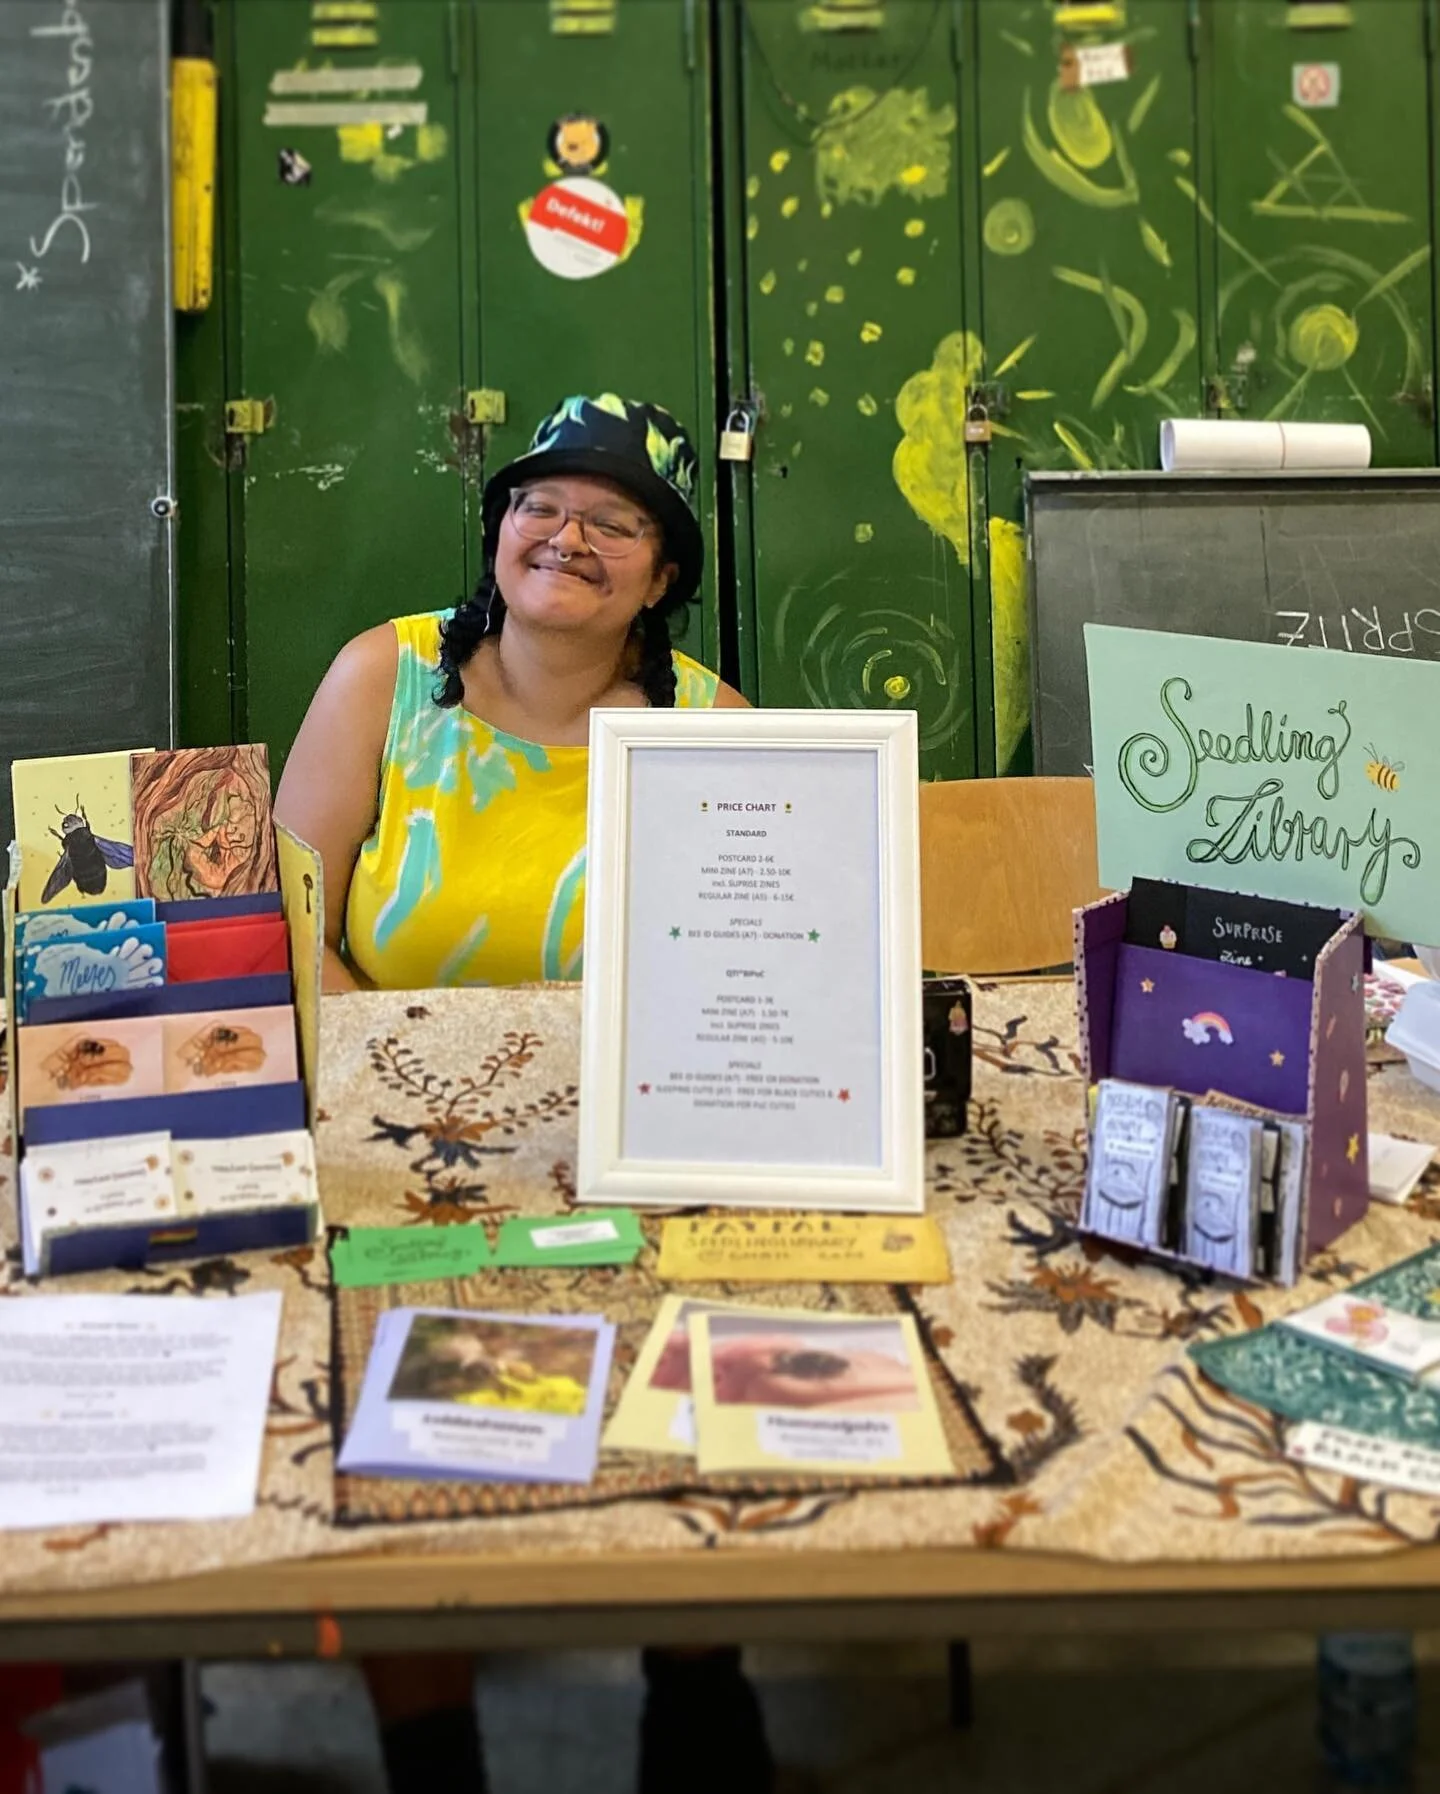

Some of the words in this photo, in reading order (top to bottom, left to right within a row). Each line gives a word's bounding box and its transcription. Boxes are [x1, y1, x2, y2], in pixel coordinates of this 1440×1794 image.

[15, 0, 99, 290] Spendenb
[1118, 677, 1351, 813] Seedling
[716, 802, 743, 812] PRICE
[745, 802, 777, 813] CHART
[726, 829, 767, 838] STANDARD
[1186, 778, 1421, 906] Library
[718, 854, 757, 863] POSTCARD
[701, 867, 718, 875] MINI
[720, 867, 736, 876] ZINE
[738, 867, 753, 877] (A7)
[759, 880, 780, 889] ZINES
[698, 892, 732, 901] REGULAR
[734, 892, 749, 901] ZINE
[729, 918, 763, 927] SPECIALS
[713, 930, 741, 939] GUIDES
[763, 931, 804, 940] DONATION
[1212, 916, 1284, 944] SURPRISE
[716, 994, 756, 1004] POSTCARD
